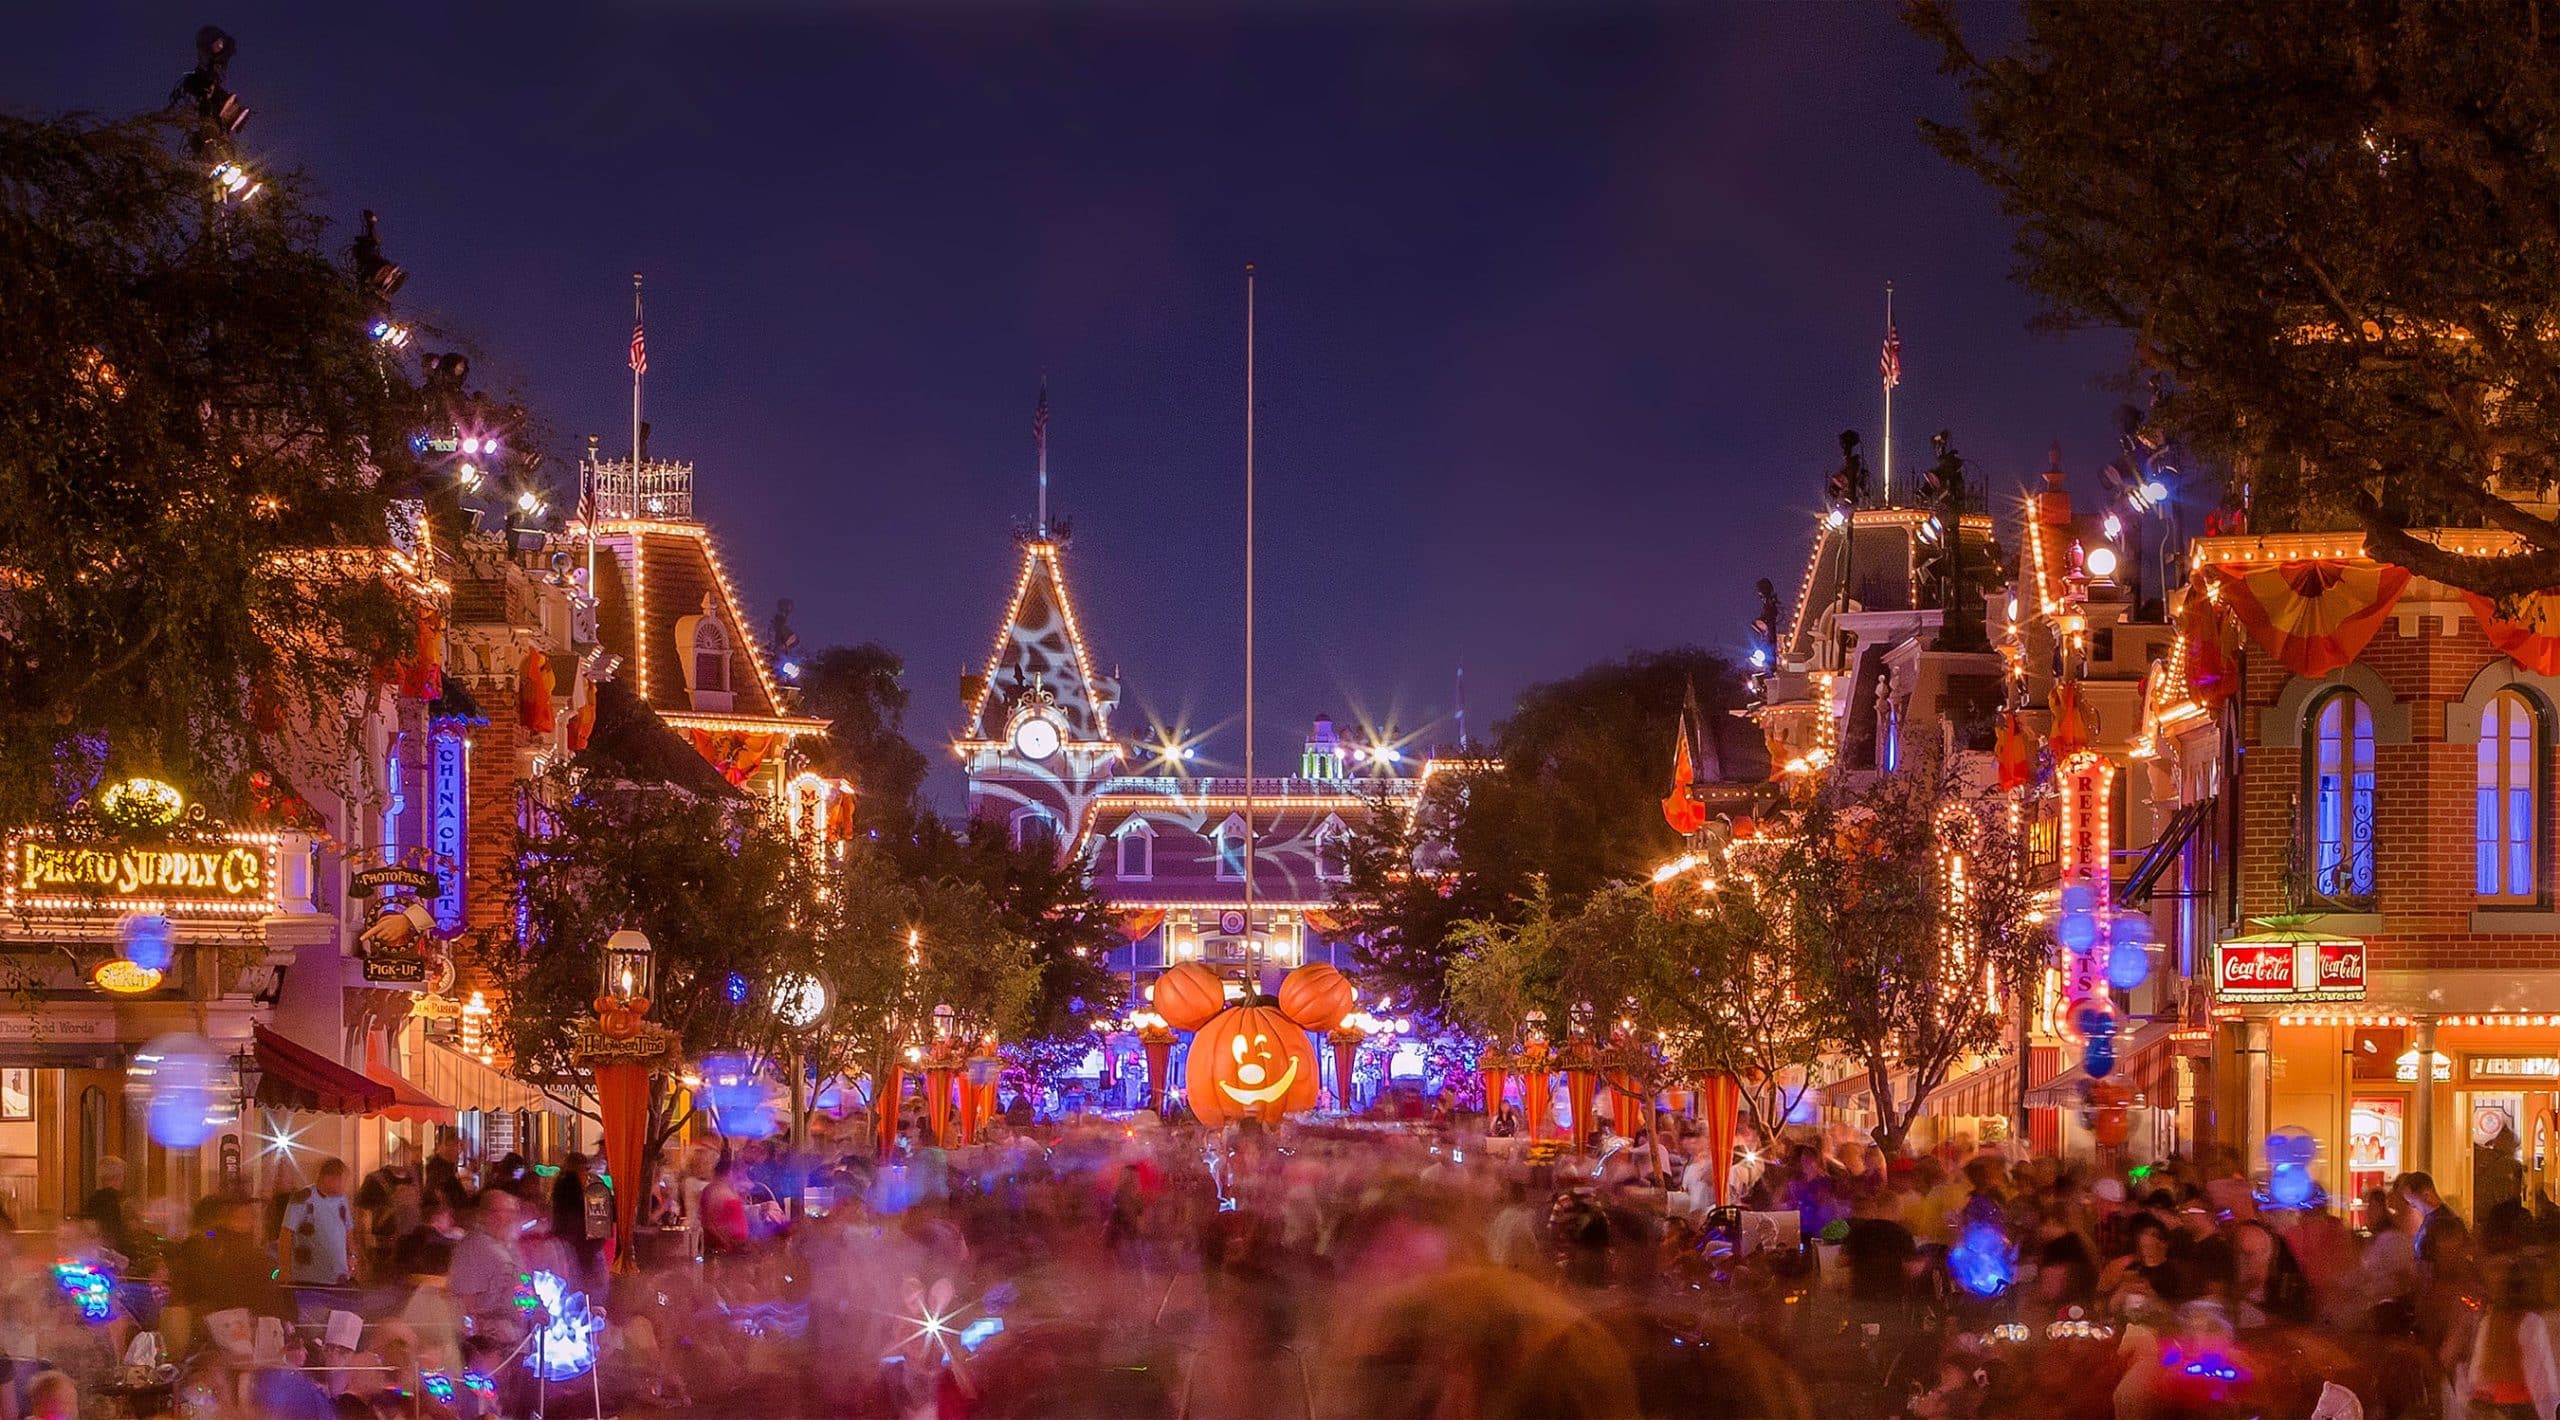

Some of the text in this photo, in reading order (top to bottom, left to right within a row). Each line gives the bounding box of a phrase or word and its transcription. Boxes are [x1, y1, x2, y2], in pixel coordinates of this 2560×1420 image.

[438, 750, 455, 818] CHINA
[118, 847, 221, 893] SUPPLY
[361, 871, 426, 885] PHOTOPASS
[370, 963, 418, 975] PICK-UP
